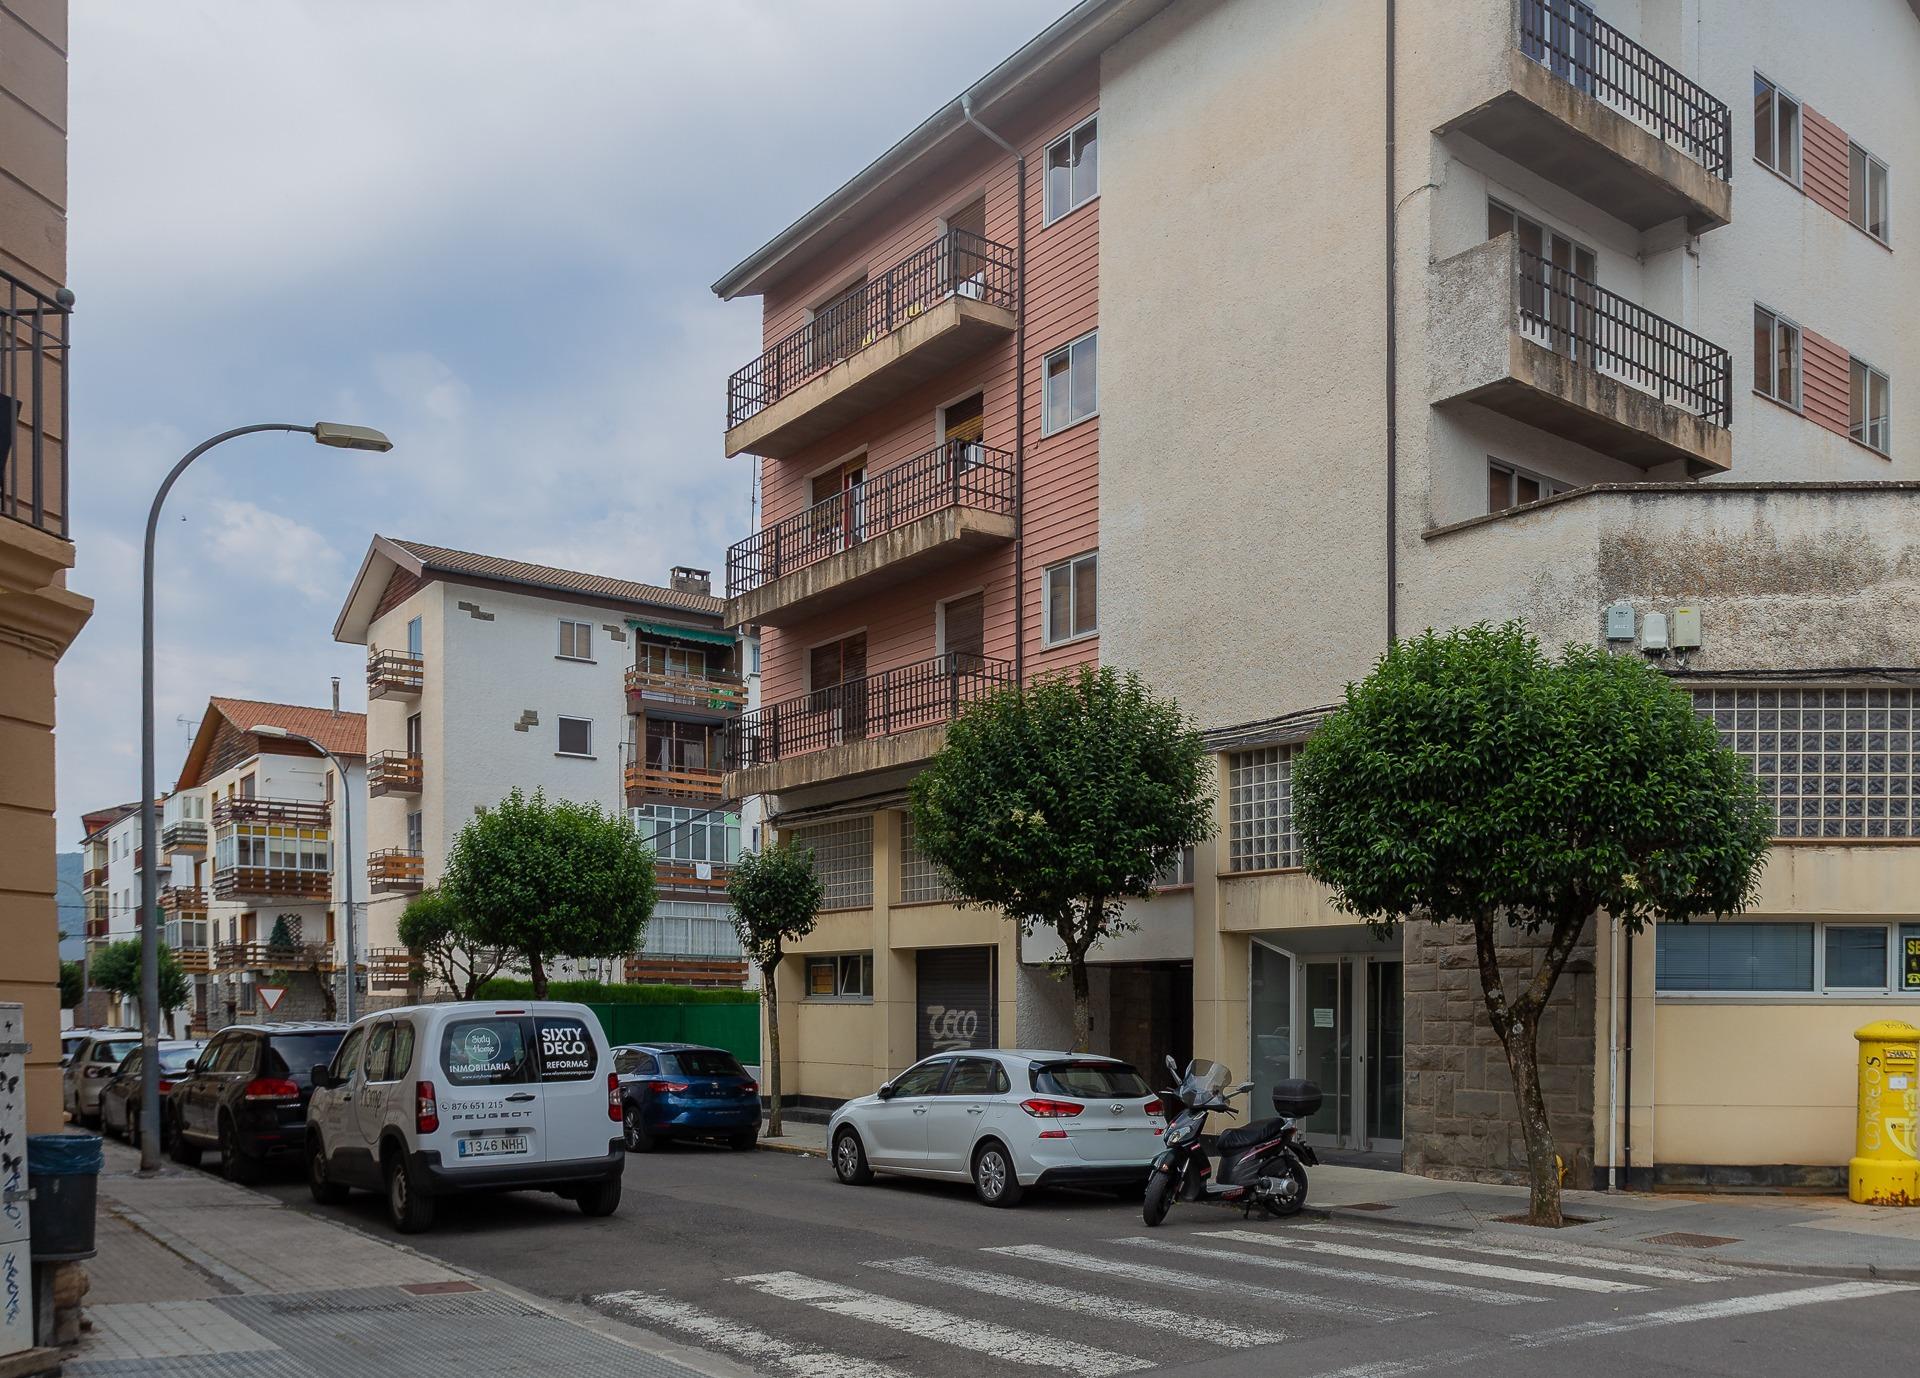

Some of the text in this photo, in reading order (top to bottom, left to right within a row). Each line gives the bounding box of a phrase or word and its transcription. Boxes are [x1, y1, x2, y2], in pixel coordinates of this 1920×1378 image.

[541, 1027, 582, 1042] SIXTY
[543, 1041, 586, 1056] DECO
[450, 1062, 511, 1073] INMOBILIARIA
[546, 1060, 589, 1069] REFORMAS
[451, 1101, 504, 1111] 876 651 215
[452, 1111, 533, 1121] PEUGEOT
[468, 1138, 524, 1153] 1346 NHH
